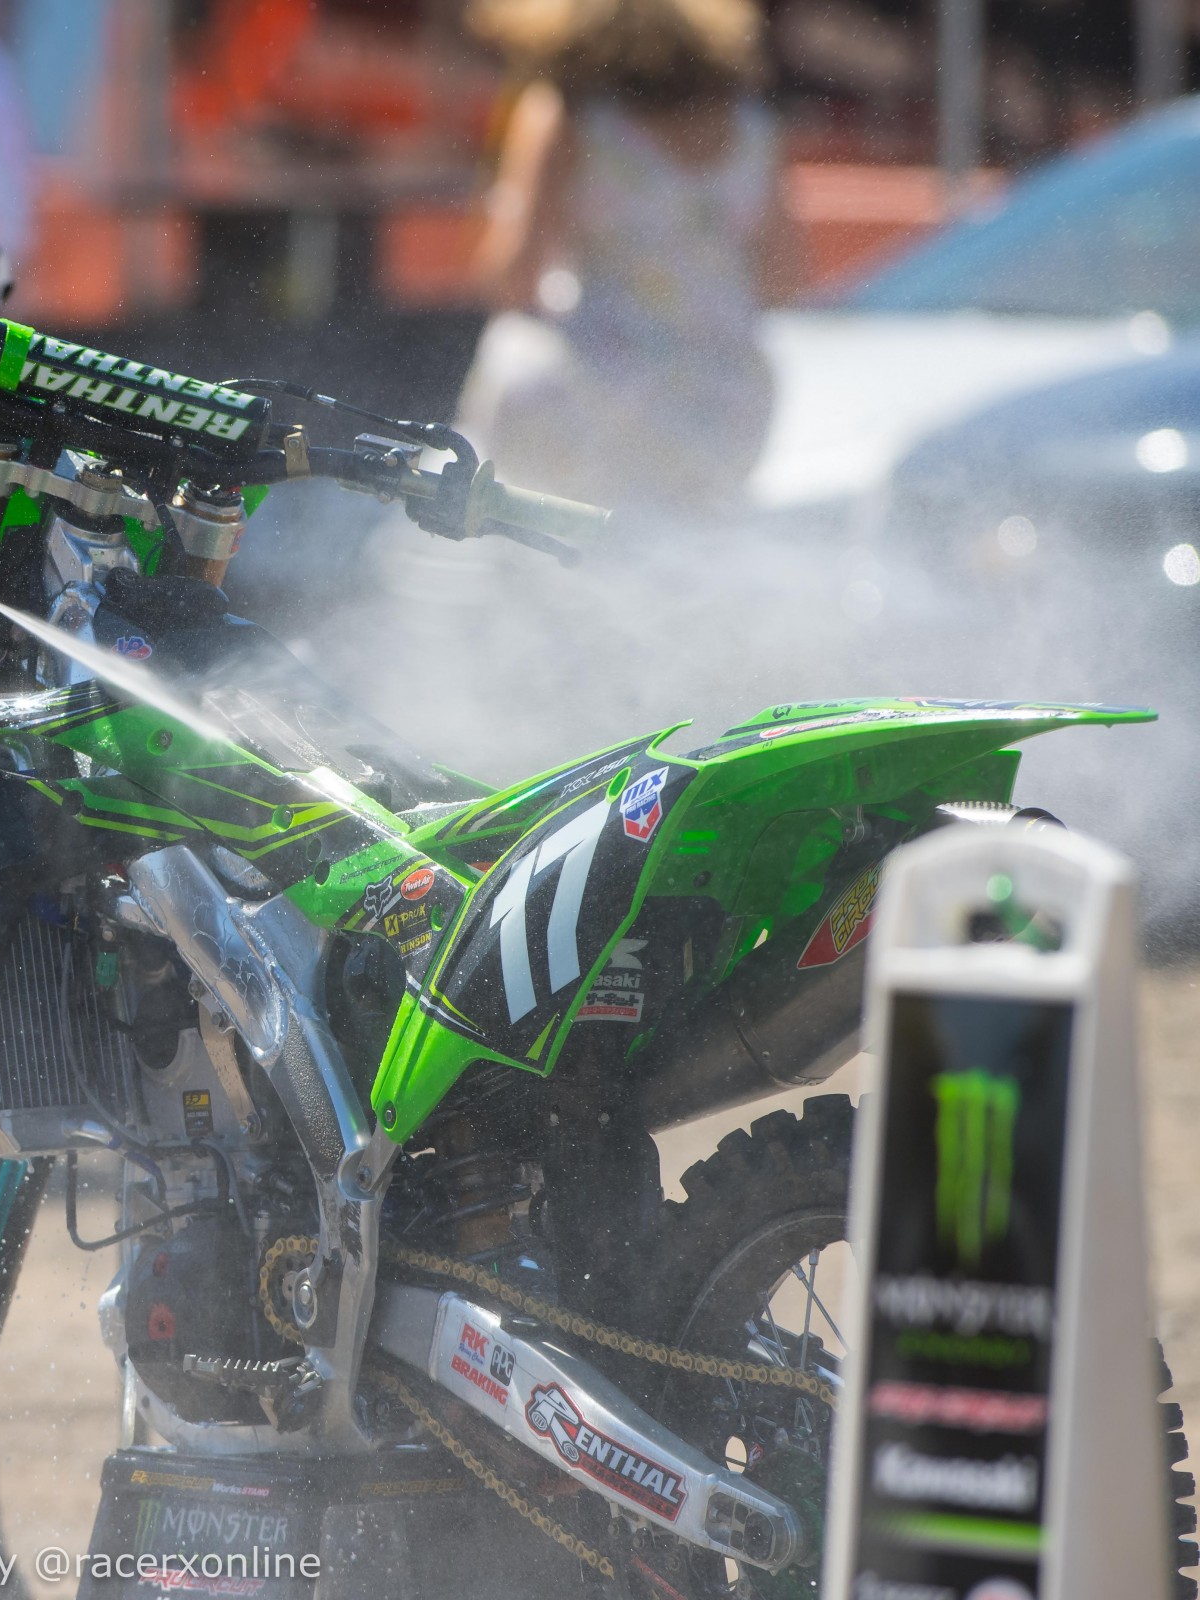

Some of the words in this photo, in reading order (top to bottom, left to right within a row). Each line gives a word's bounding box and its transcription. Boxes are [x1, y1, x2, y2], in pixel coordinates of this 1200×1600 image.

[405, 880, 421, 892] Twin
[420, 874, 432, 885] Air
[400, 932, 431, 954] HINSON
[593, 973, 641, 989] asaki
[461, 1323, 488, 1358] RK
[451, 1354, 509, 1406] BRAKING
[163, 1505, 288, 1544] MONSTER
